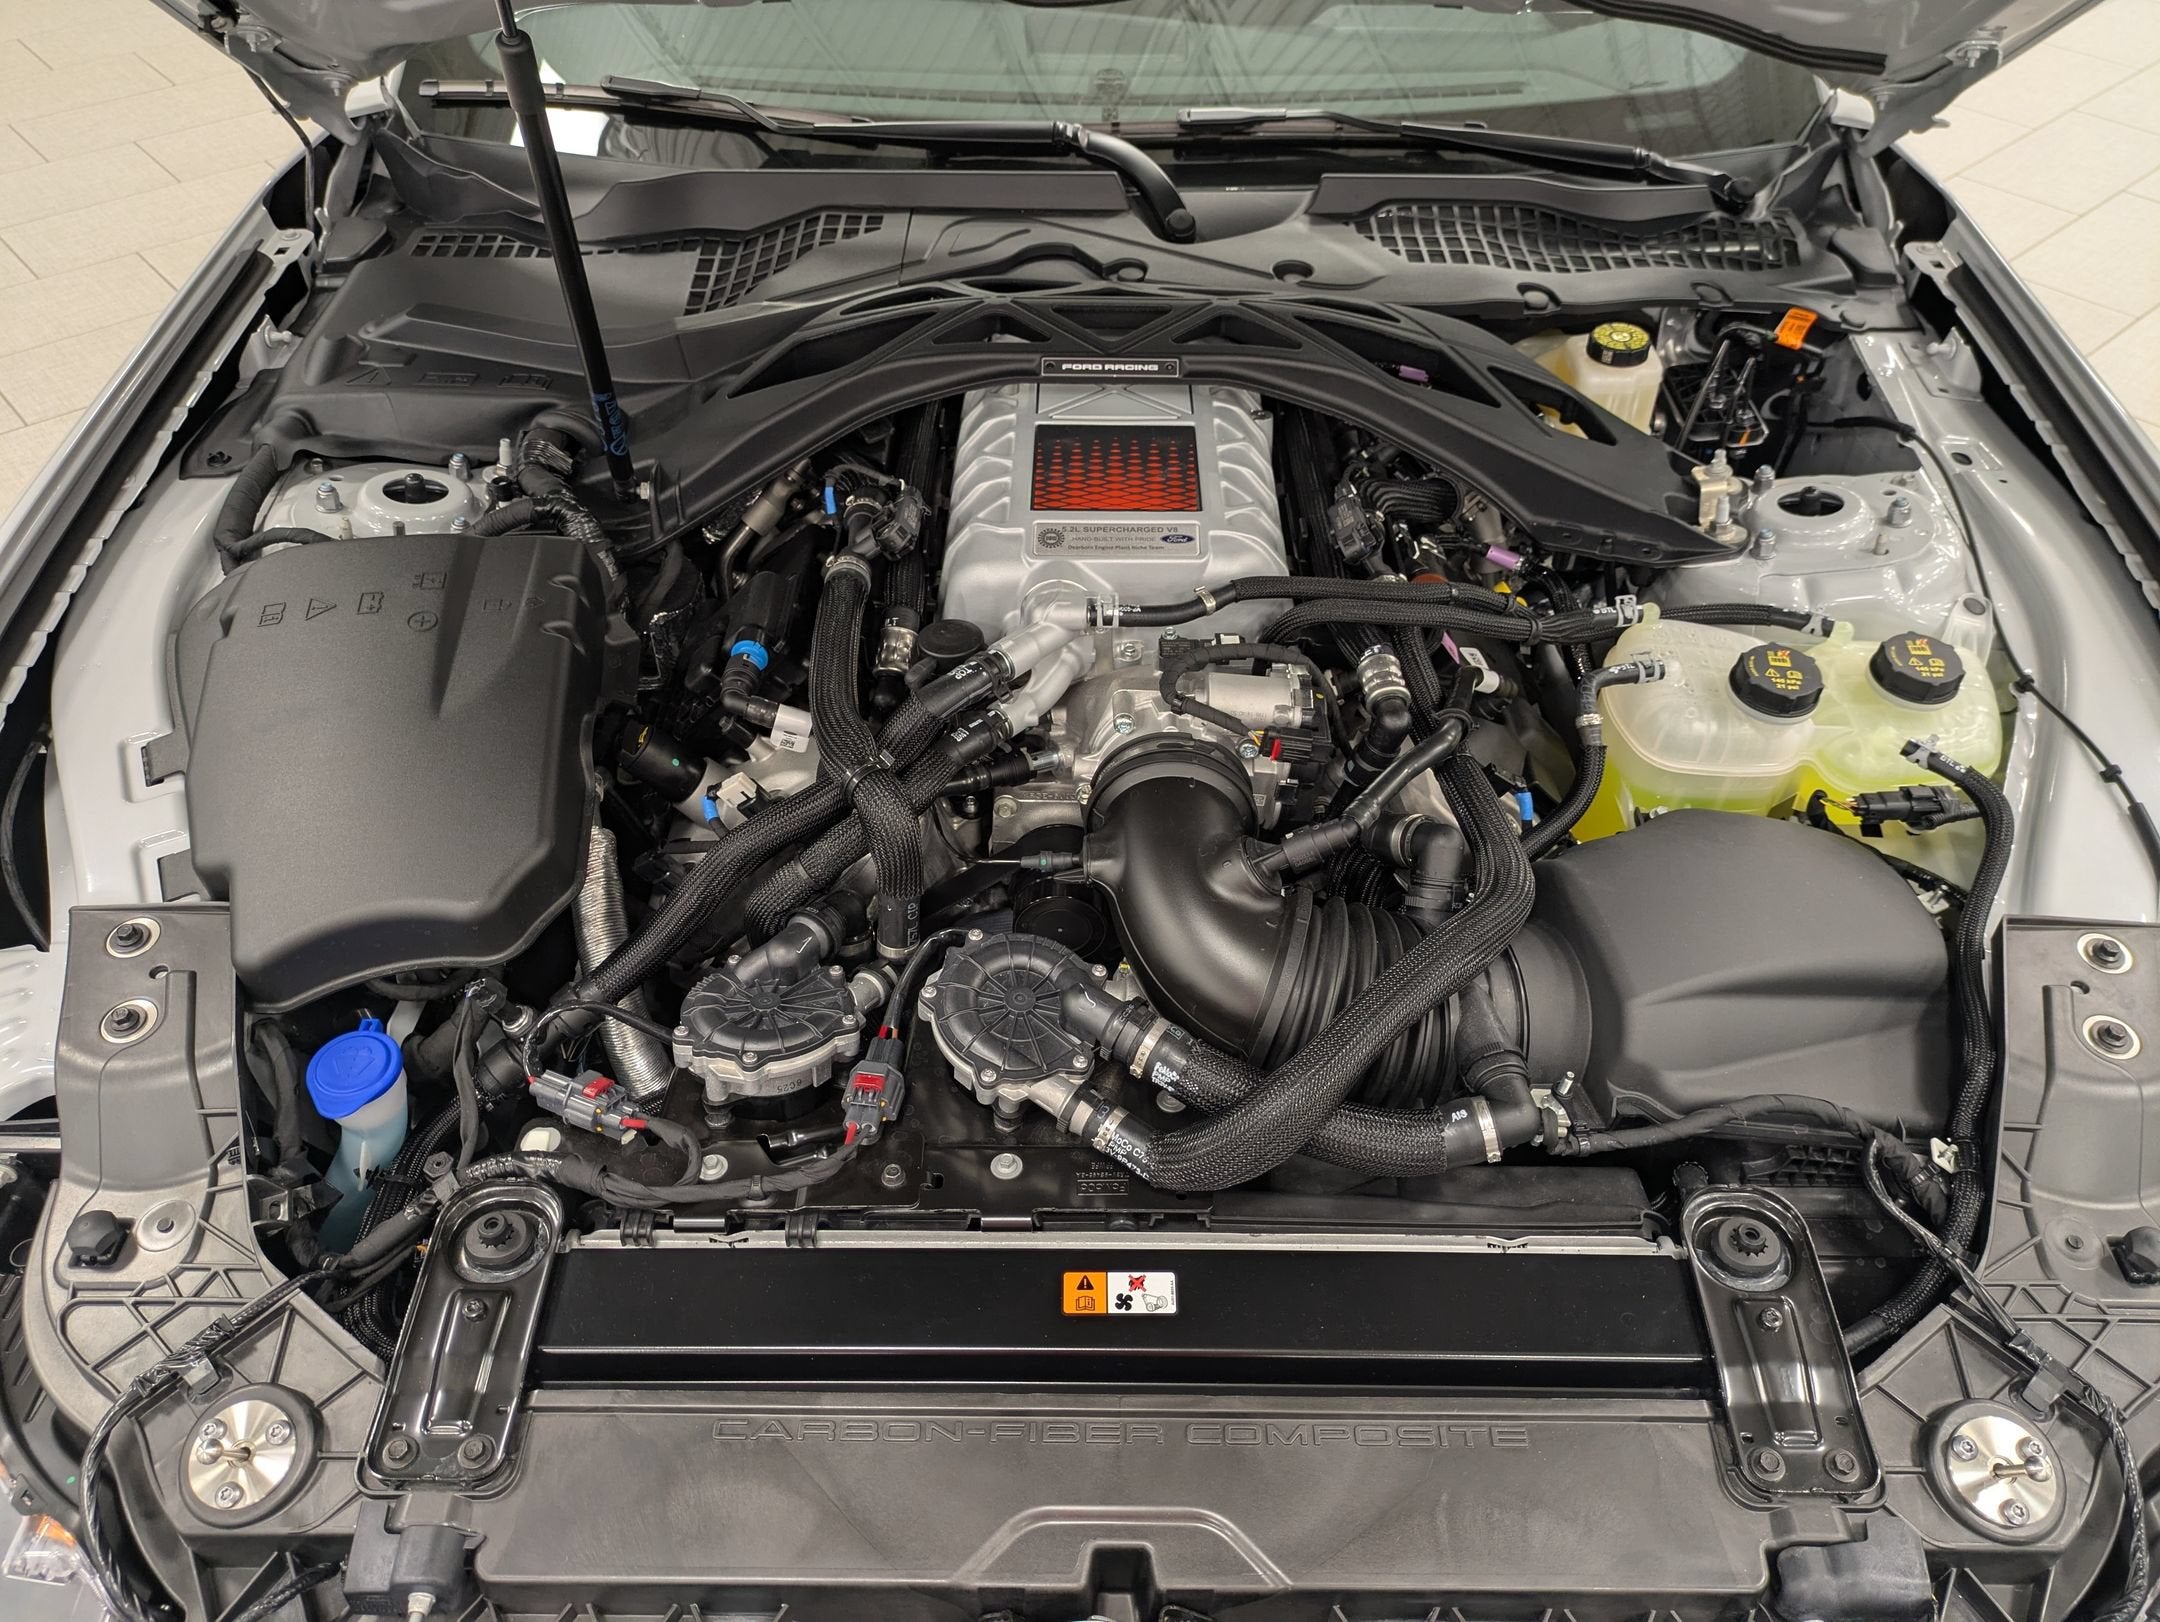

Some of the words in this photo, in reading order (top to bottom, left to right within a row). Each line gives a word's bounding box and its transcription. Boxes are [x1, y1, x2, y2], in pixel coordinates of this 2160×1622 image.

[1062, 363, 1103, 371] FORD
[1108, 1141, 1128, 1155] PMP
[712, 1418, 1165, 1445] CARBON-FIBER
[1186, 1422, 1530, 1449] COMPOSITE
